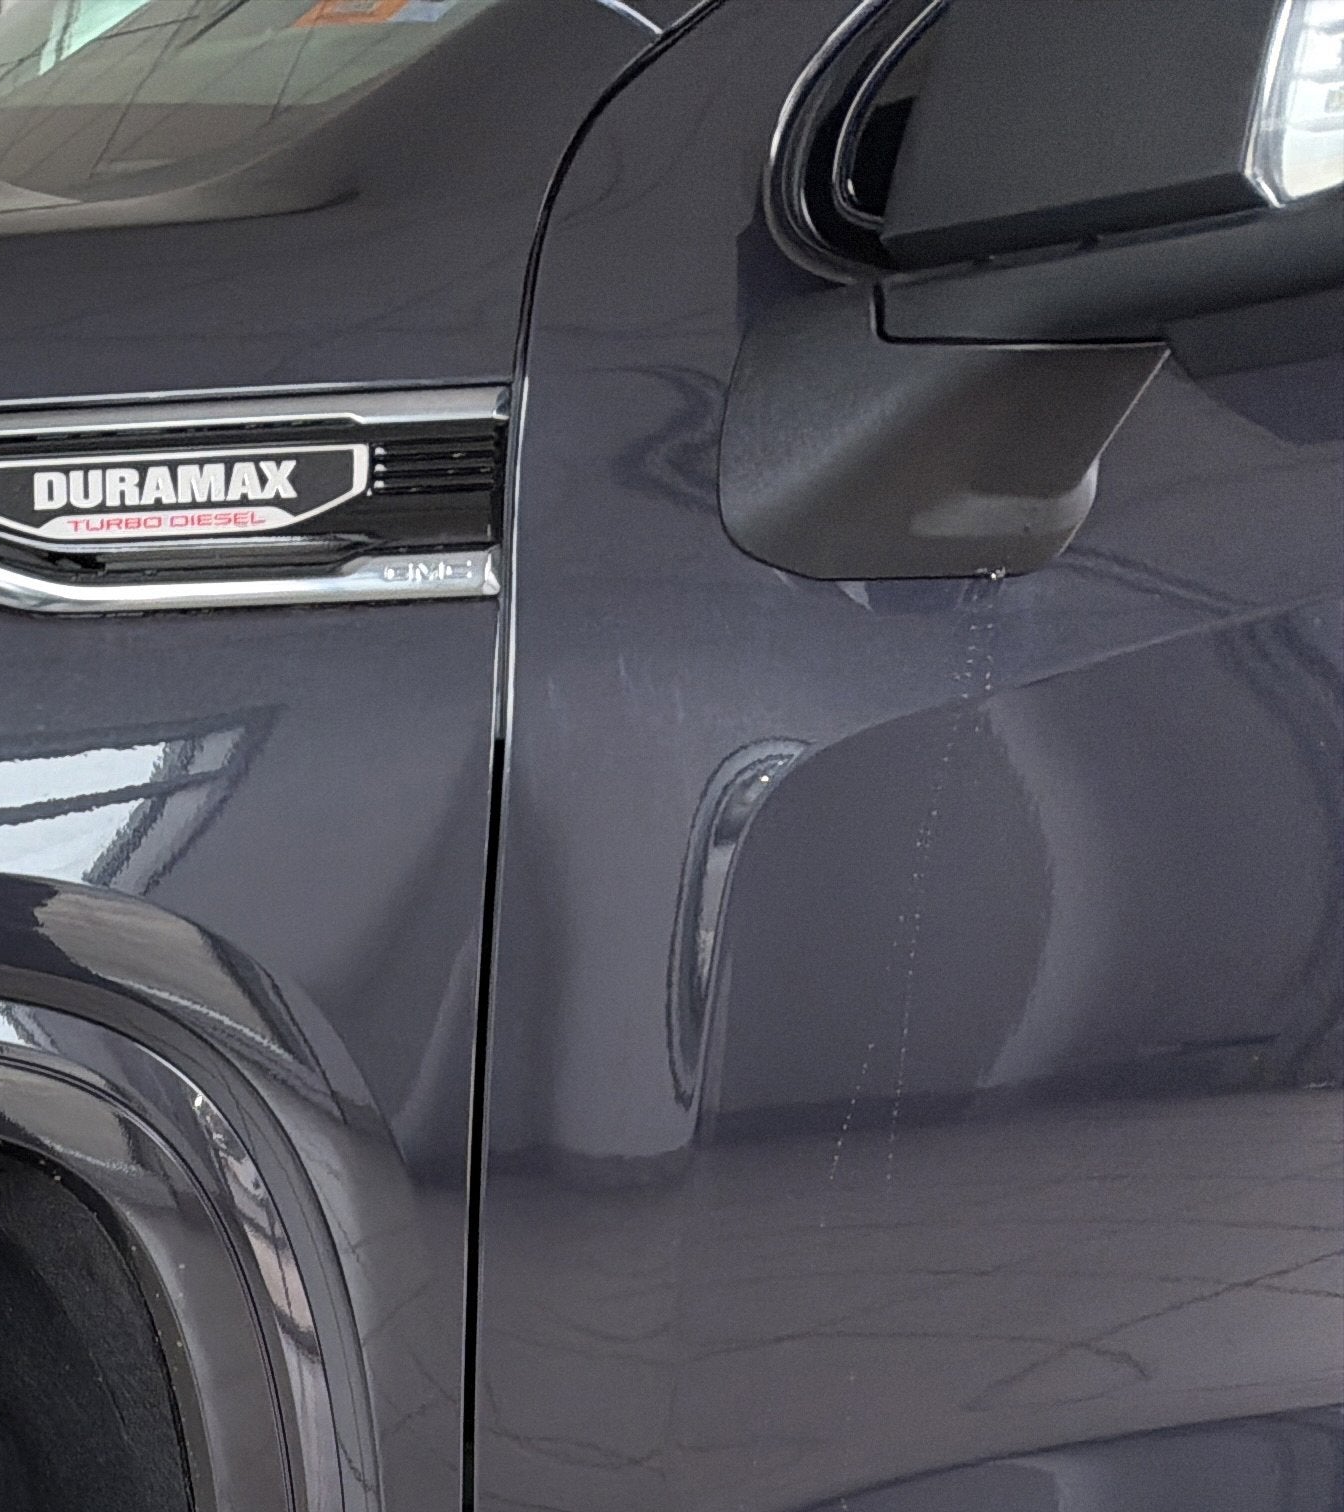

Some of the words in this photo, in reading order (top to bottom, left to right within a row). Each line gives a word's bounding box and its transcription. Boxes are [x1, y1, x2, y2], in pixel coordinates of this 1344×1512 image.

[33, 459, 298, 511] DURAMAX
[67, 514, 162, 533] TURBO
[169, 510, 267, 528] DIESEL
